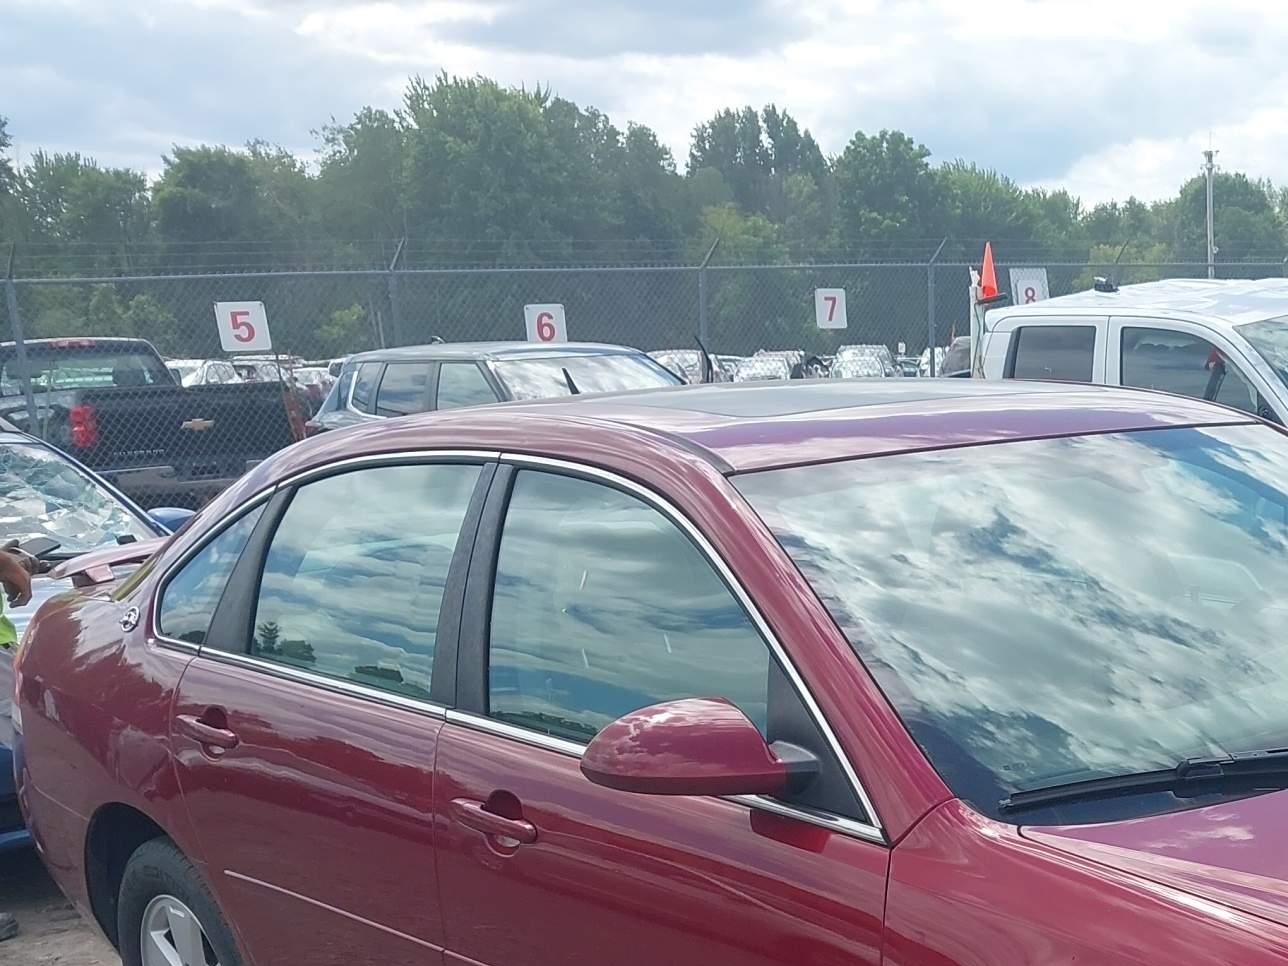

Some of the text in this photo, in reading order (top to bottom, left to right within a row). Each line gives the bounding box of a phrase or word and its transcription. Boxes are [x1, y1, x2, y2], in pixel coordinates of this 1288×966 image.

[823, 296, 837, 322] 7
[230, 310, 256, 343] 5
[536, 312, 555, 342] 6
